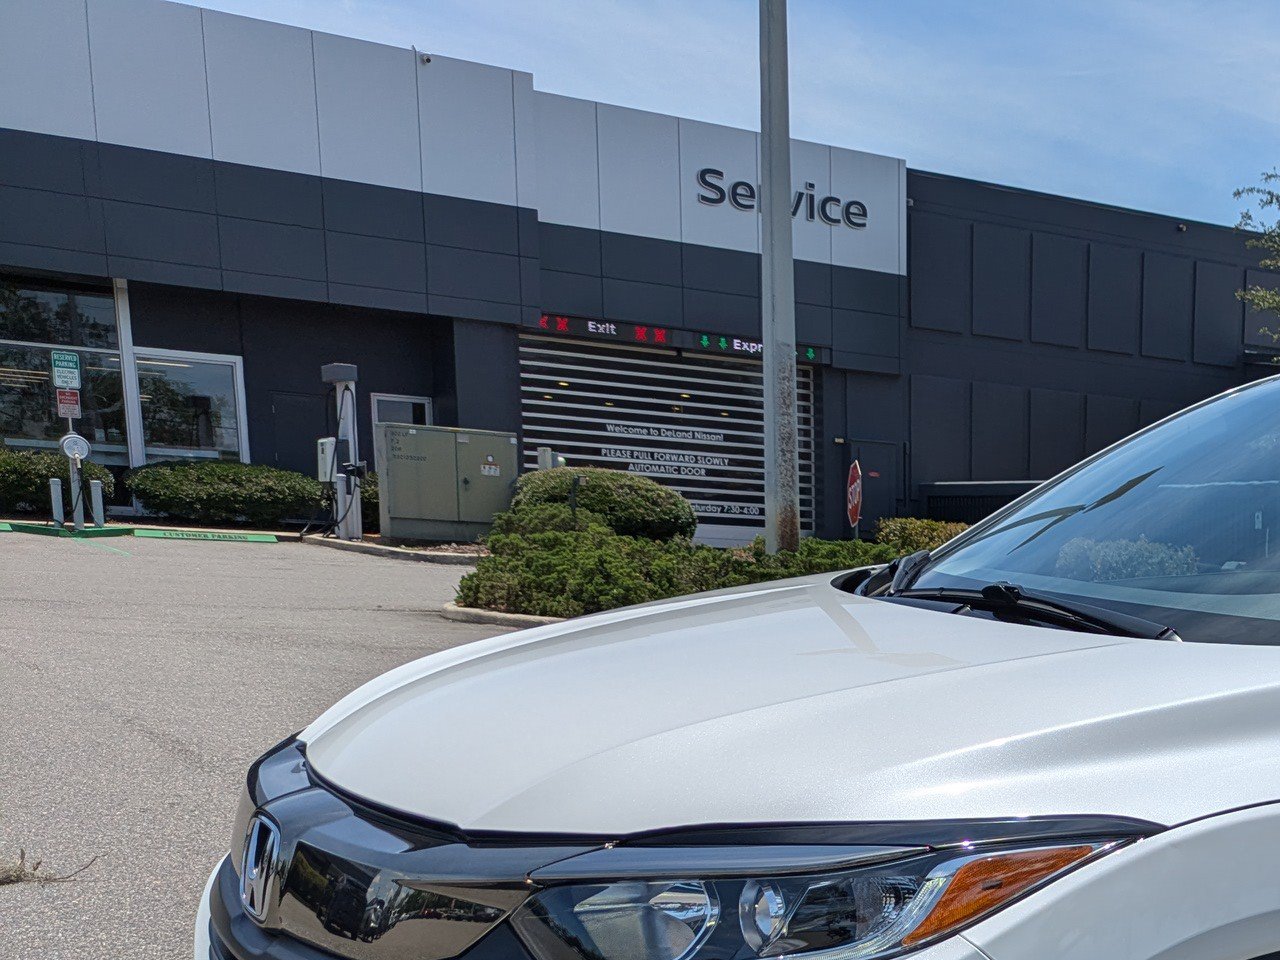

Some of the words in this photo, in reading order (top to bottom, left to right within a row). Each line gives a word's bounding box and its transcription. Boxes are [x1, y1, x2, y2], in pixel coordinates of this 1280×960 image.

[697, 168, 868, 229] Sevice
[587, 321, 617, 335] Exit
[606, 424, 649, 436] Welcome
[650, 428, 659, 436] to
[661, 429, 693, 439] DeLand
[694, 432, 724, 441] Nissan!
[601, 448, 632, 458] PLEASE
[633, 451, 652, 460] PULL
[654, 453, 696, 463] FORWARD
[697, 456, 730, 466] SLOWLY
[628, 463, 679, 474] AUTOMATIC
[680, 467, 707, 476] DOOR
[691, 504, 722, 514] aturday
[723, 505, 760, 515] 7:30-4:00
